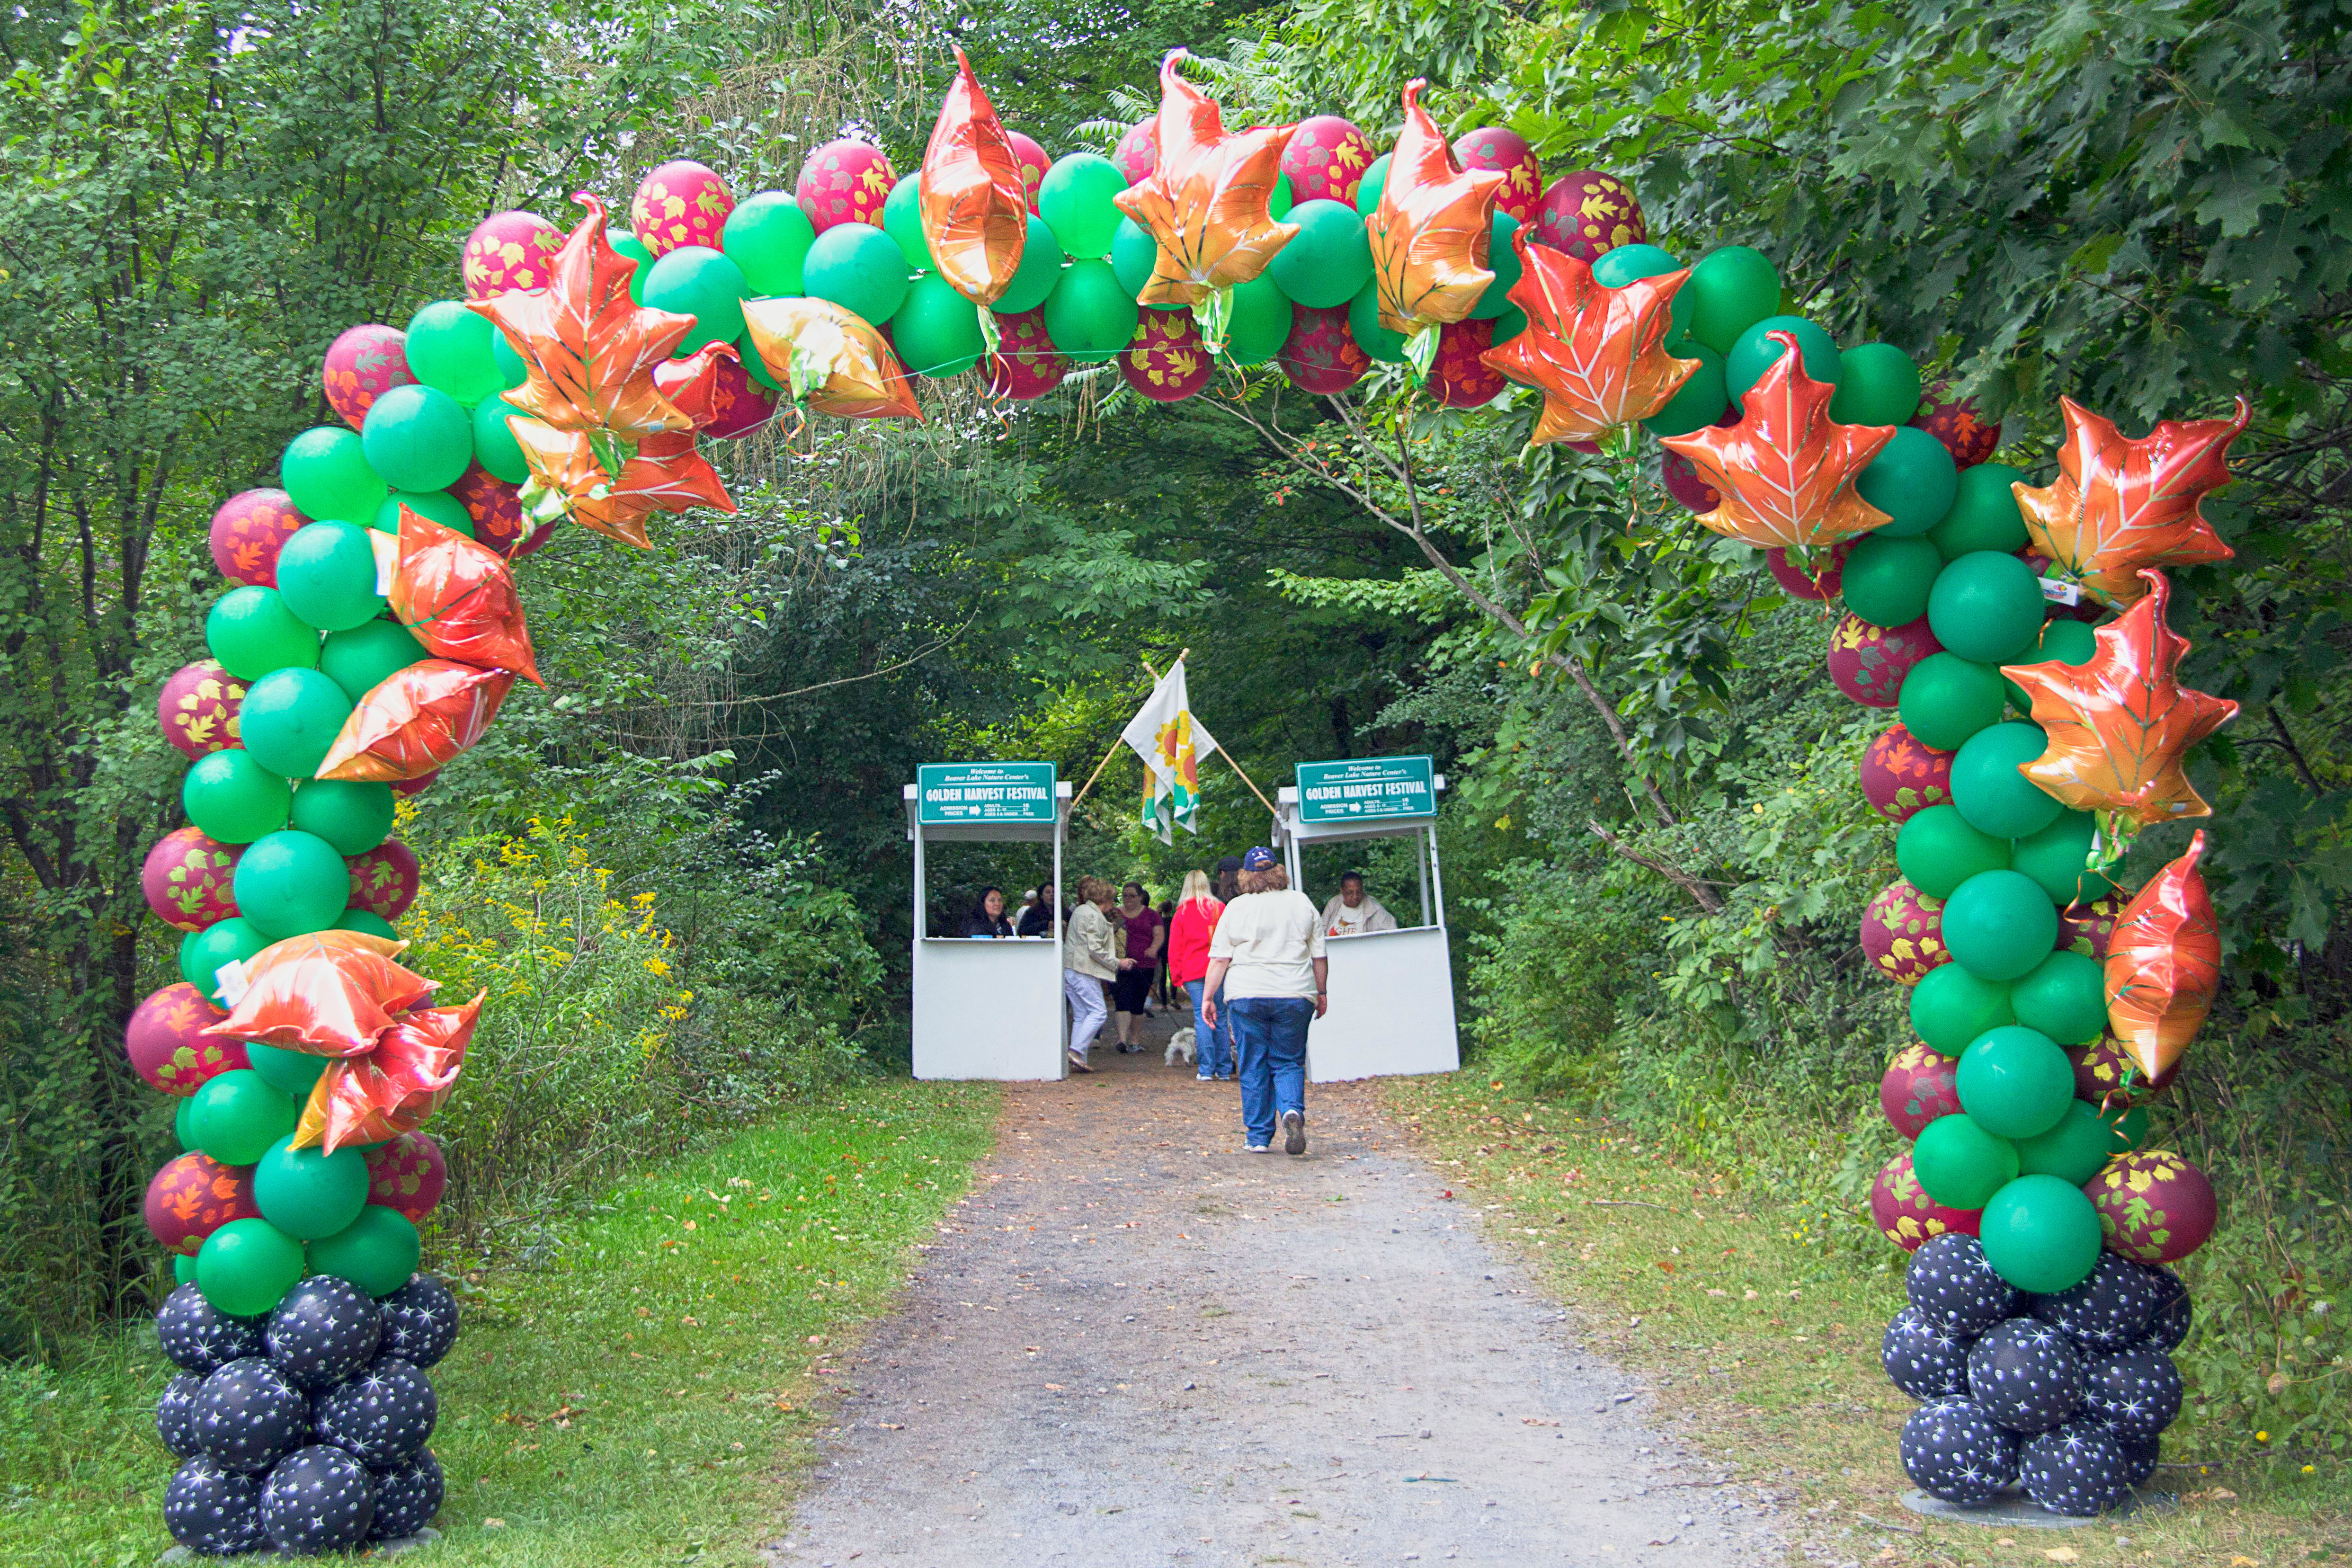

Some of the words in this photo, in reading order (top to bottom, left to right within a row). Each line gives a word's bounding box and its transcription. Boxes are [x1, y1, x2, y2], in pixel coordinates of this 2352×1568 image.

[926, 789, 962, 801] GOLDEN
[964, 788, 1004, 800] HARVEST
[1007, 787, 1048, 800] FESTIVAL
[1306, 786, 1341, 801] GOLDEN
[1343, 784, 1382, 798] HARVEST
[1385, 781, 1427, 795] FESTIVAL
